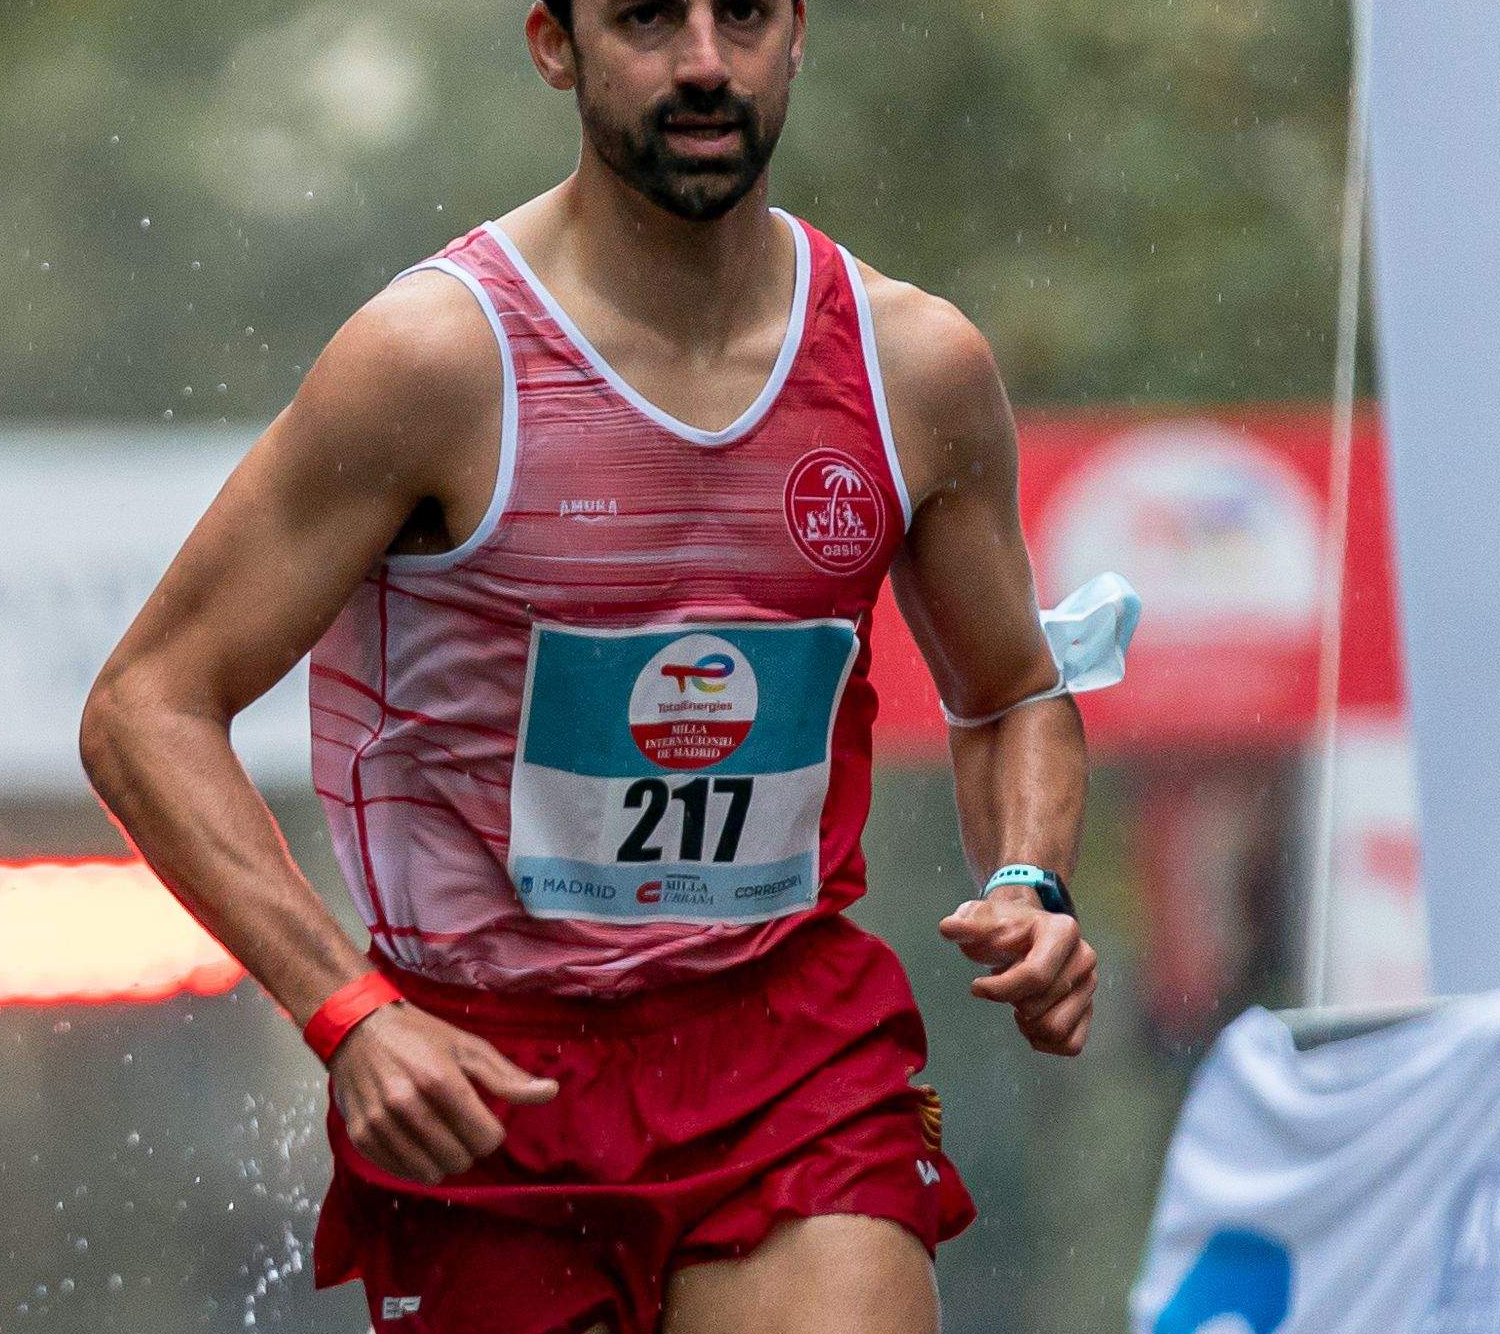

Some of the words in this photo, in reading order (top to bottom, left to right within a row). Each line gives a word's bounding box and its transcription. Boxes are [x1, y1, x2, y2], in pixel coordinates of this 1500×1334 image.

[823, 541, 862, 556] oasis
[657, 700, 733, 713] TotalEnergies
[671, 723, 708, 735] MILLA
[657, 748, 672, 759] DE
[674, 747, 721, 758] MADRID
[617, 776, 755, 862] 217
[542, 877, 617, 900] MADRID
[664, 880, 708, 892] MILLA
